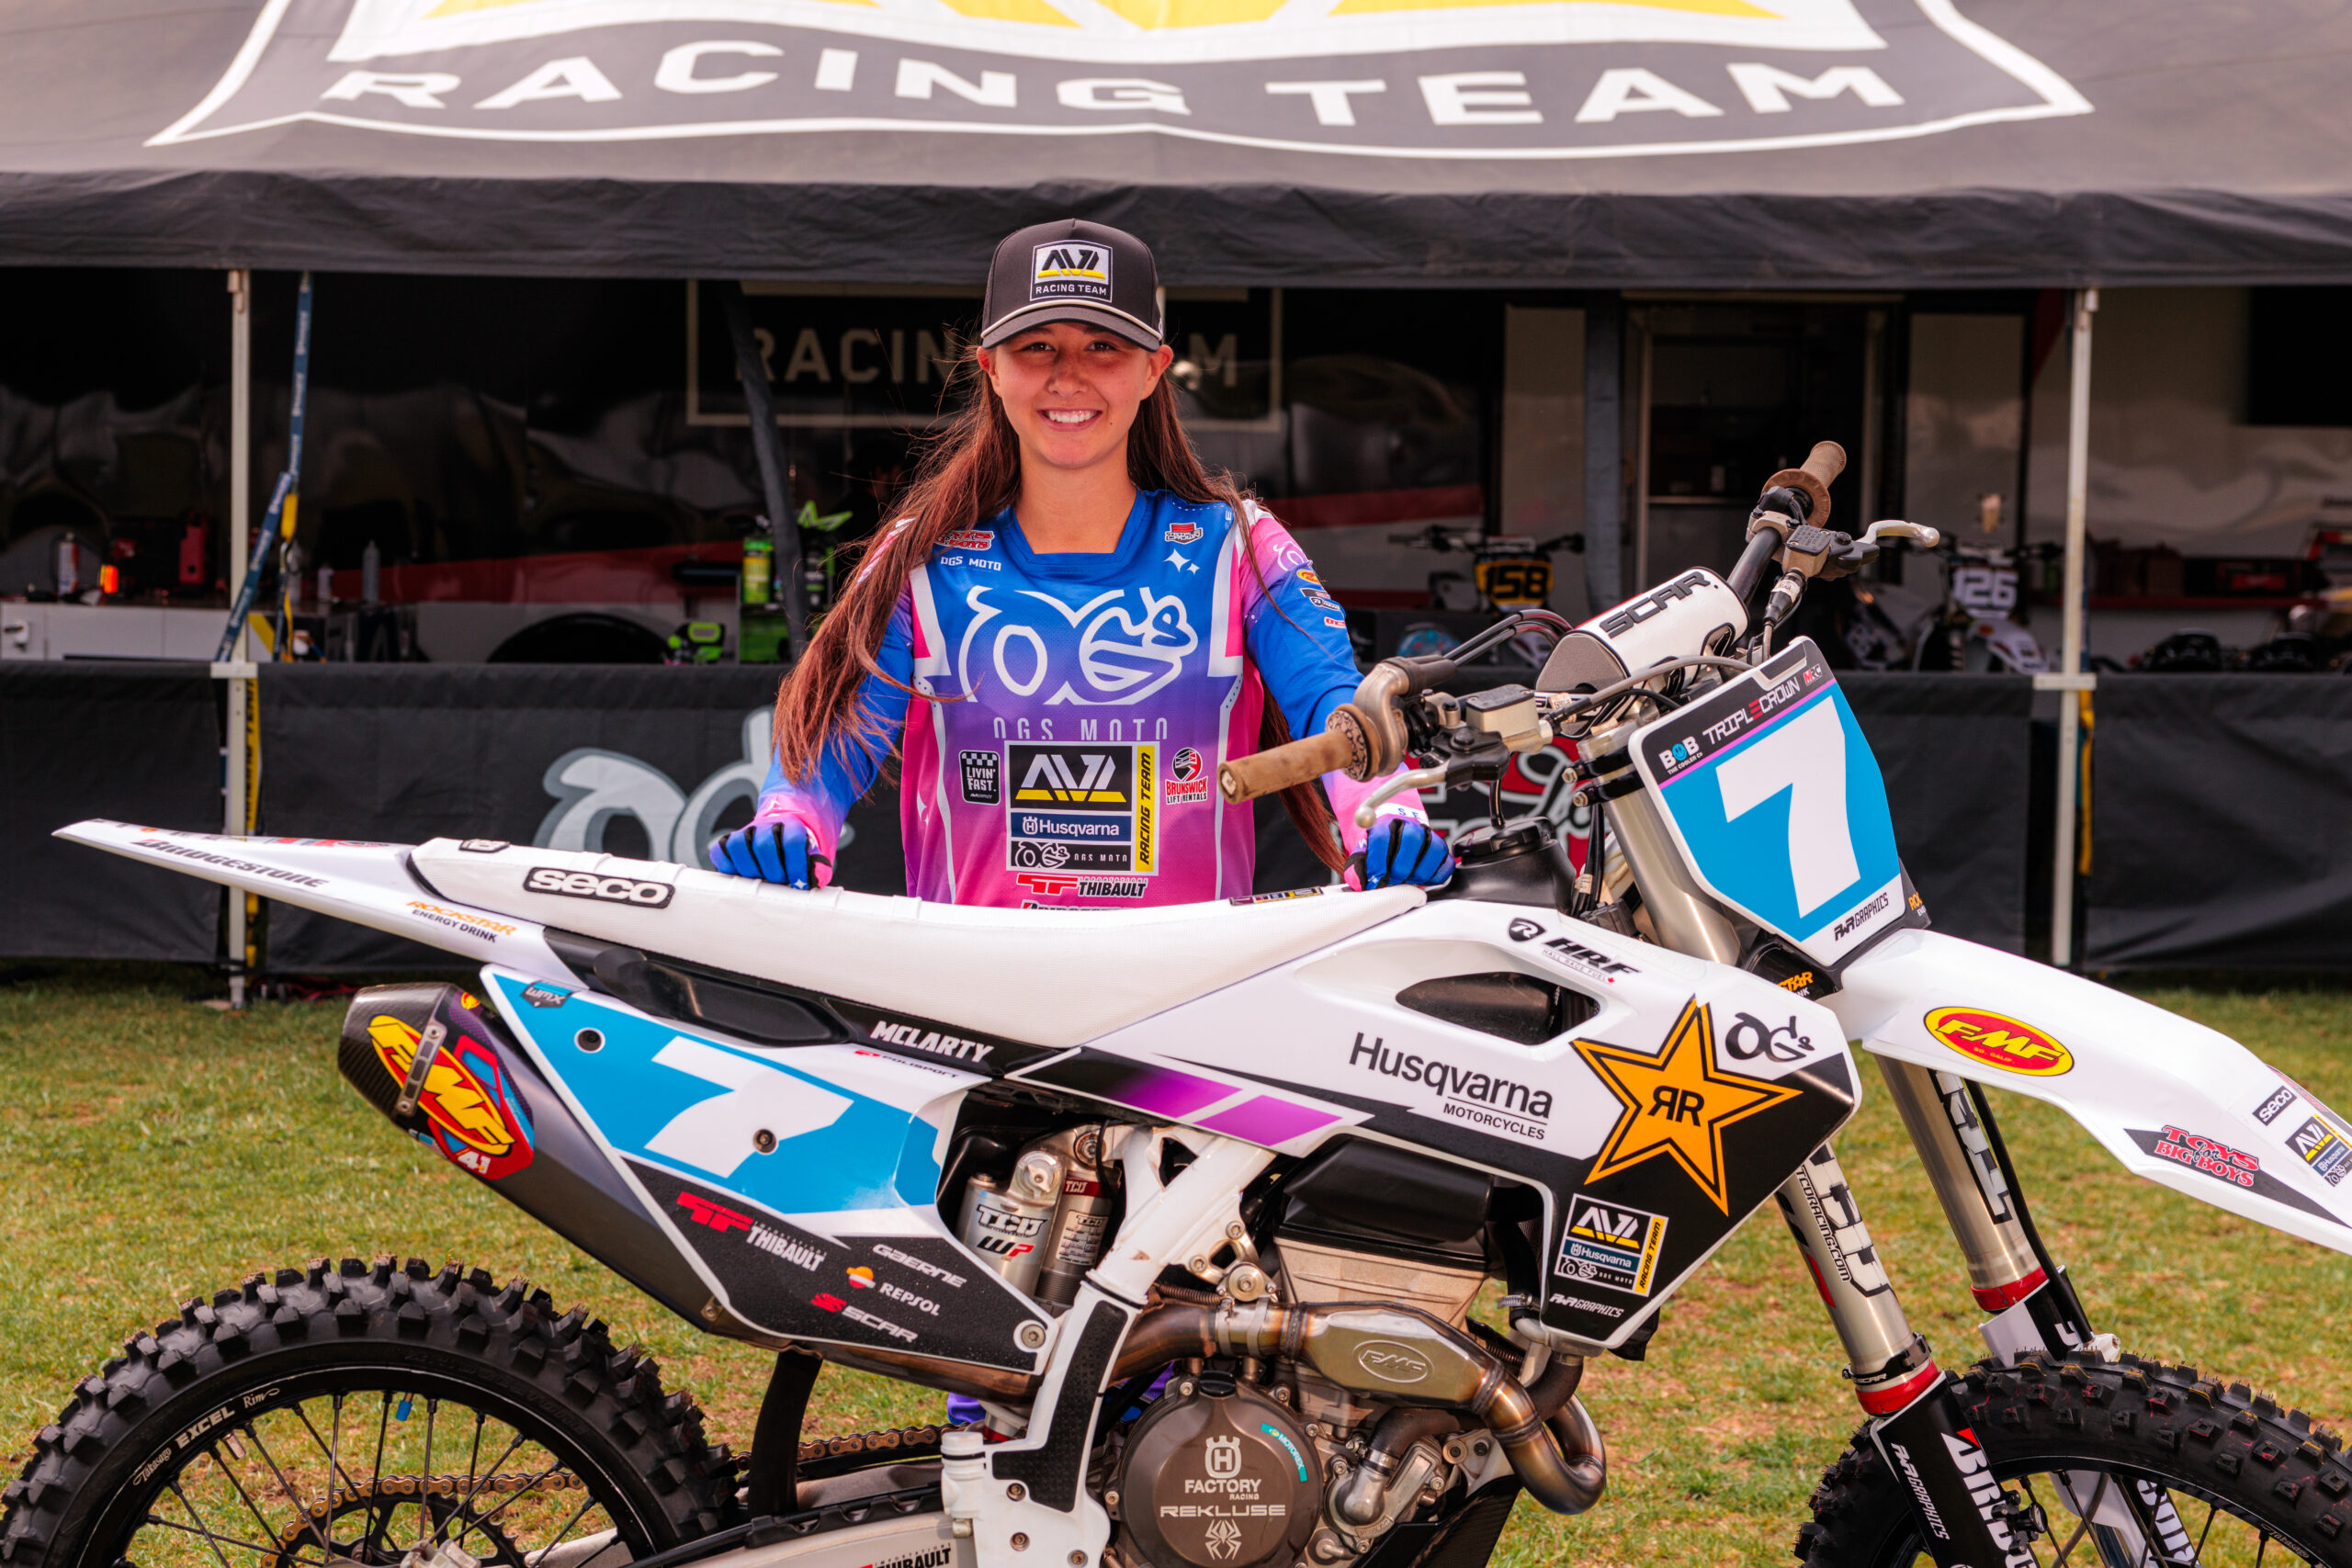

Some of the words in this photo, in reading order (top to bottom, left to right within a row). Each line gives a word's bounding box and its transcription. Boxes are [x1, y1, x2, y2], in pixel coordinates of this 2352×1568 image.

[320, 40, 1192, 114] RACING
[1264, 62, 1905, 126] TEAM
[1035, 284, 1075, 295] RACING
[1078, 285, 1107, 296] TEAM
[735, 327, 958, 384] RACIN
[940, 556, 964, 566] OGS
[968, 558, 1001, 571] MOTO
[1486, 564, 1550, 598] 158
[1600, 571, 1711, 638] SCAR
[967, 766, 996, 779] LIVIN'
[1141, 752, 1151, 800] TEAM
[1668, 765, 1679, 775] THE
[1678, 755, 1697, 769] COOLER
[1166, 776, 1208, 796] BRUNSWICK
[1167, 795, 1181, 804] LIFT
[1182, 793, 1207, 803] RENTALS
[1715, 695, 1860, 919] 7
[1040, 819, 1119, 837] Husqvarna
[1139, 805, 1151, 865] RACING
[130, 839, 329, 887] BRIDGESTONE
[1079, 882, 1147, 897] THIBAULT
[406, 901, 516, 935] ROCKSTAR
[413, 909, 459, 928] ENERGY
[459, 923, 497, 943] DRINK
[1544, 938, 1641, 974] HRF
[870, 1021, 994, 1063] MCLARTY
[1935, 1019, 2065, 1061] FMF
[1349, 1032, 1553, 1119] Husqvarna
[645, 1035, 854, 1179] 7
[1443, 1103, 1545, 1140] MOTORCYCLES
[2154, 1140, 2193, 1165] BIG
[2197, 1155, 2254, 1187] BOYS
[2163, 1126, 2259, 1170] TOYS
[746, 1226, 825, 1271] THIBAULT
[1580, 1247, 1632, 1268] Husqvarna
[1640, 1255, 1653, 1289] RACING
[1649, 1222, 1661, 1253] TEAM
[879, 1282, 941, 1317] REPSOL
[842, 1304, 918, 1344] SCAR
[133, 1448, 172, 1486] Takasago
[174, 1406, 235, 1450] EXCEL
[243, 1388, 279, 1409] Rim
[1278, 1433, 1306, 1470] MOTOREX
[1184, 1479, 1261, 1494] FACTORY
[1229, 1493, 1260, 1501] RACING
[1159, 1505, 1286, 1517] REKLUSE
